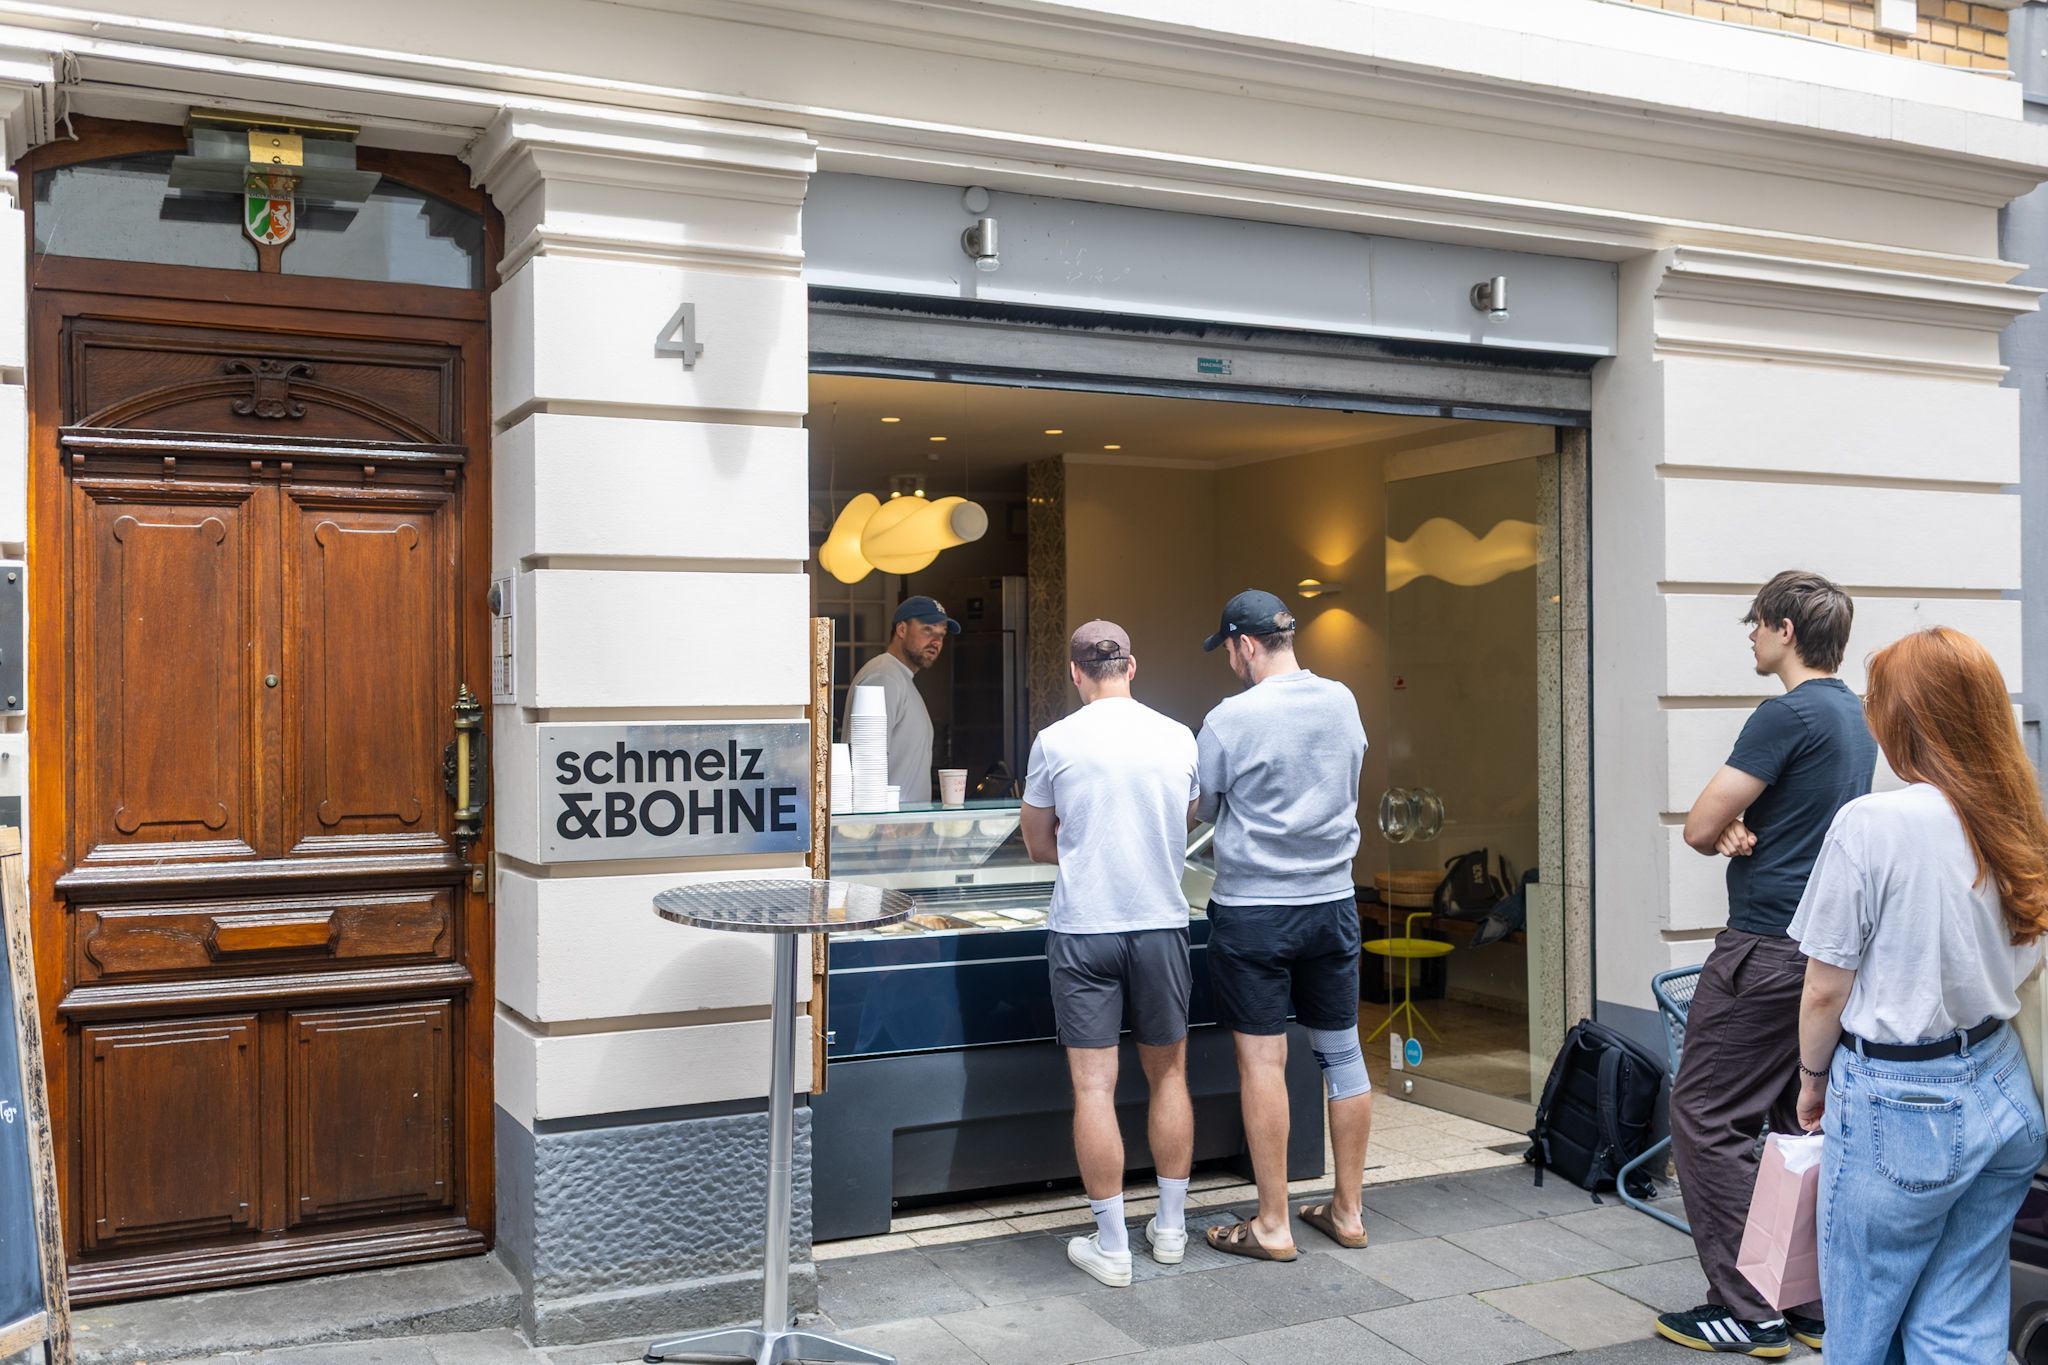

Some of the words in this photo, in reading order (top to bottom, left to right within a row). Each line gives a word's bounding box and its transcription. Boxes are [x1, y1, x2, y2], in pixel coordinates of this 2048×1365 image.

[655, 303, 704, 367] 4
[556, 740, 764, 785] schmelz
[557, 787, 797, 839] &BOHNE
